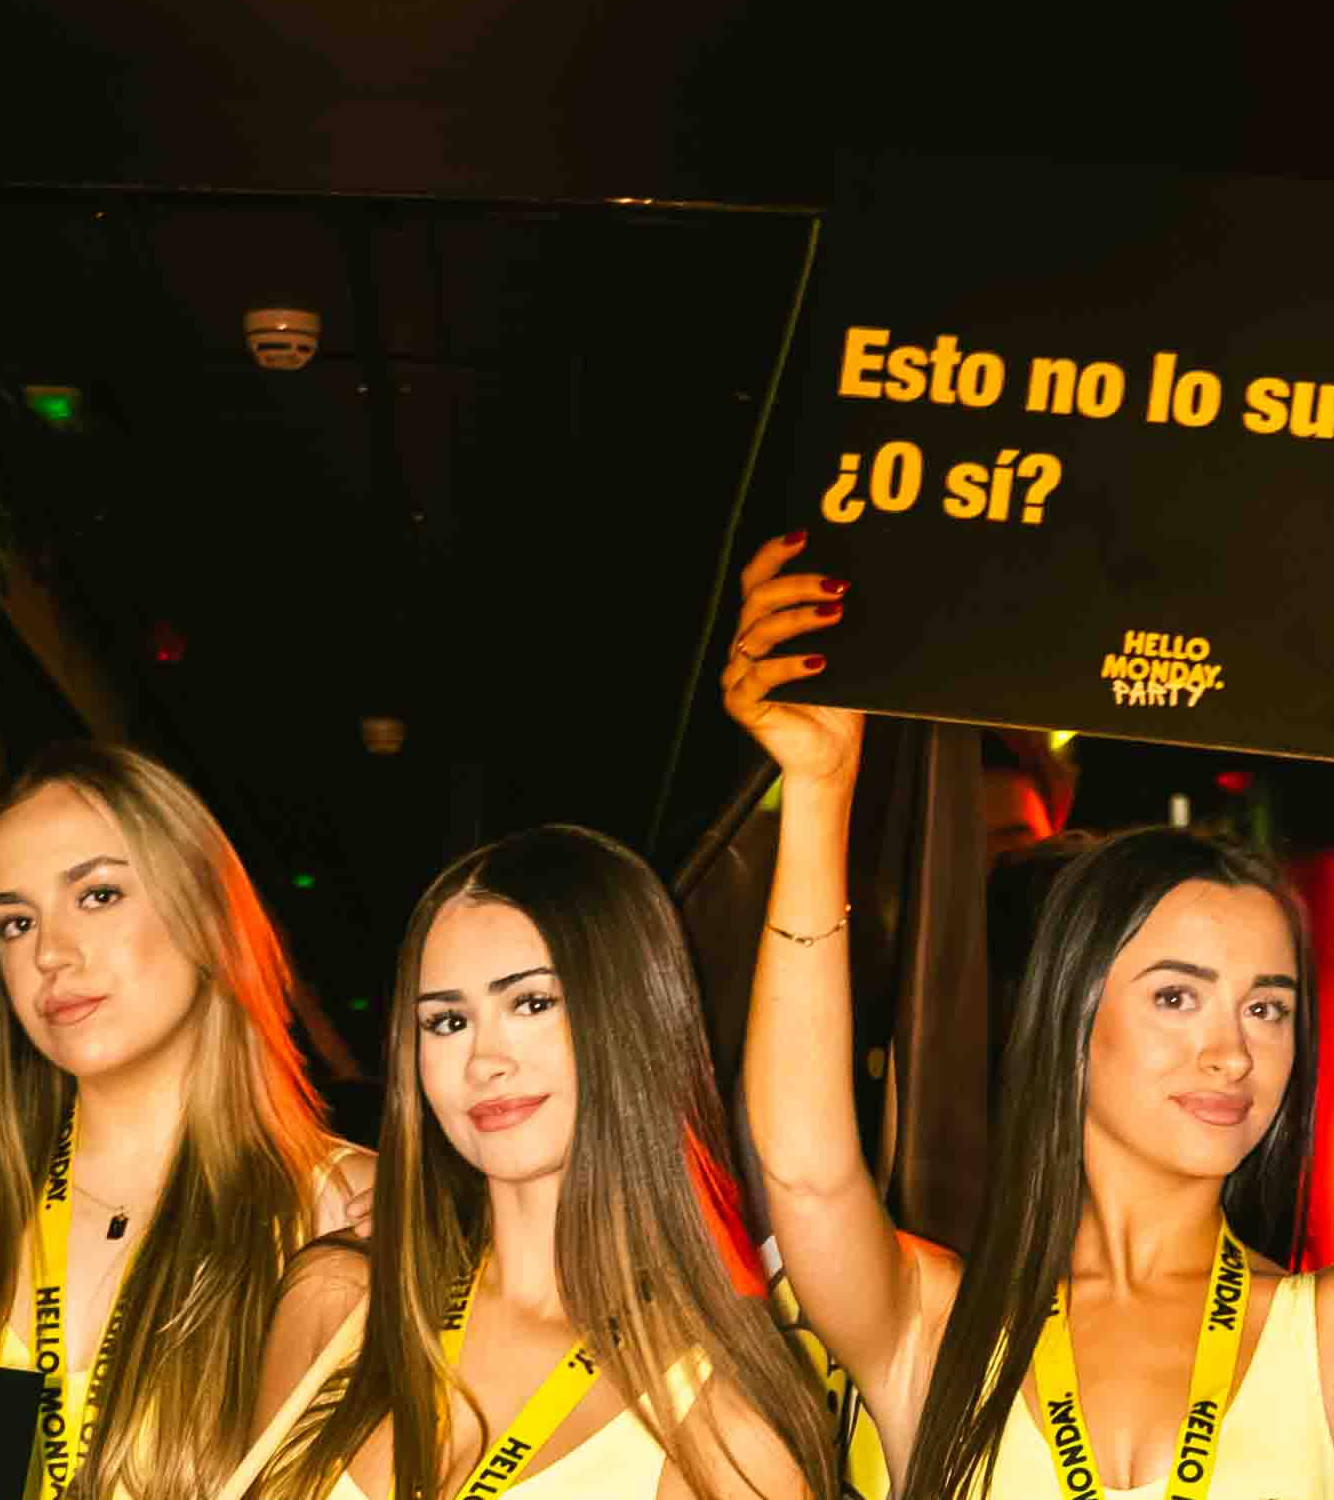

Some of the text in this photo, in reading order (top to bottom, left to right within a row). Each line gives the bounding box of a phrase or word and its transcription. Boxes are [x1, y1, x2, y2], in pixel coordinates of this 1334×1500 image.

[837, 326, 1006, 408] Esto
[1024, 357, 1126, 419] no
[1146, 351, 1222, 428] lo
[821, 440, 1063, 525] ¿O sí?
[1101, 653, 1225, 690] MONDAY.
[1123, 629, 1211, 662] HELLO
[1113, 679, 1207, 708] PARTY
[35, 1285, 61, 1374] HELLO
[1176, 1399, 1218, 1484] HELLO
